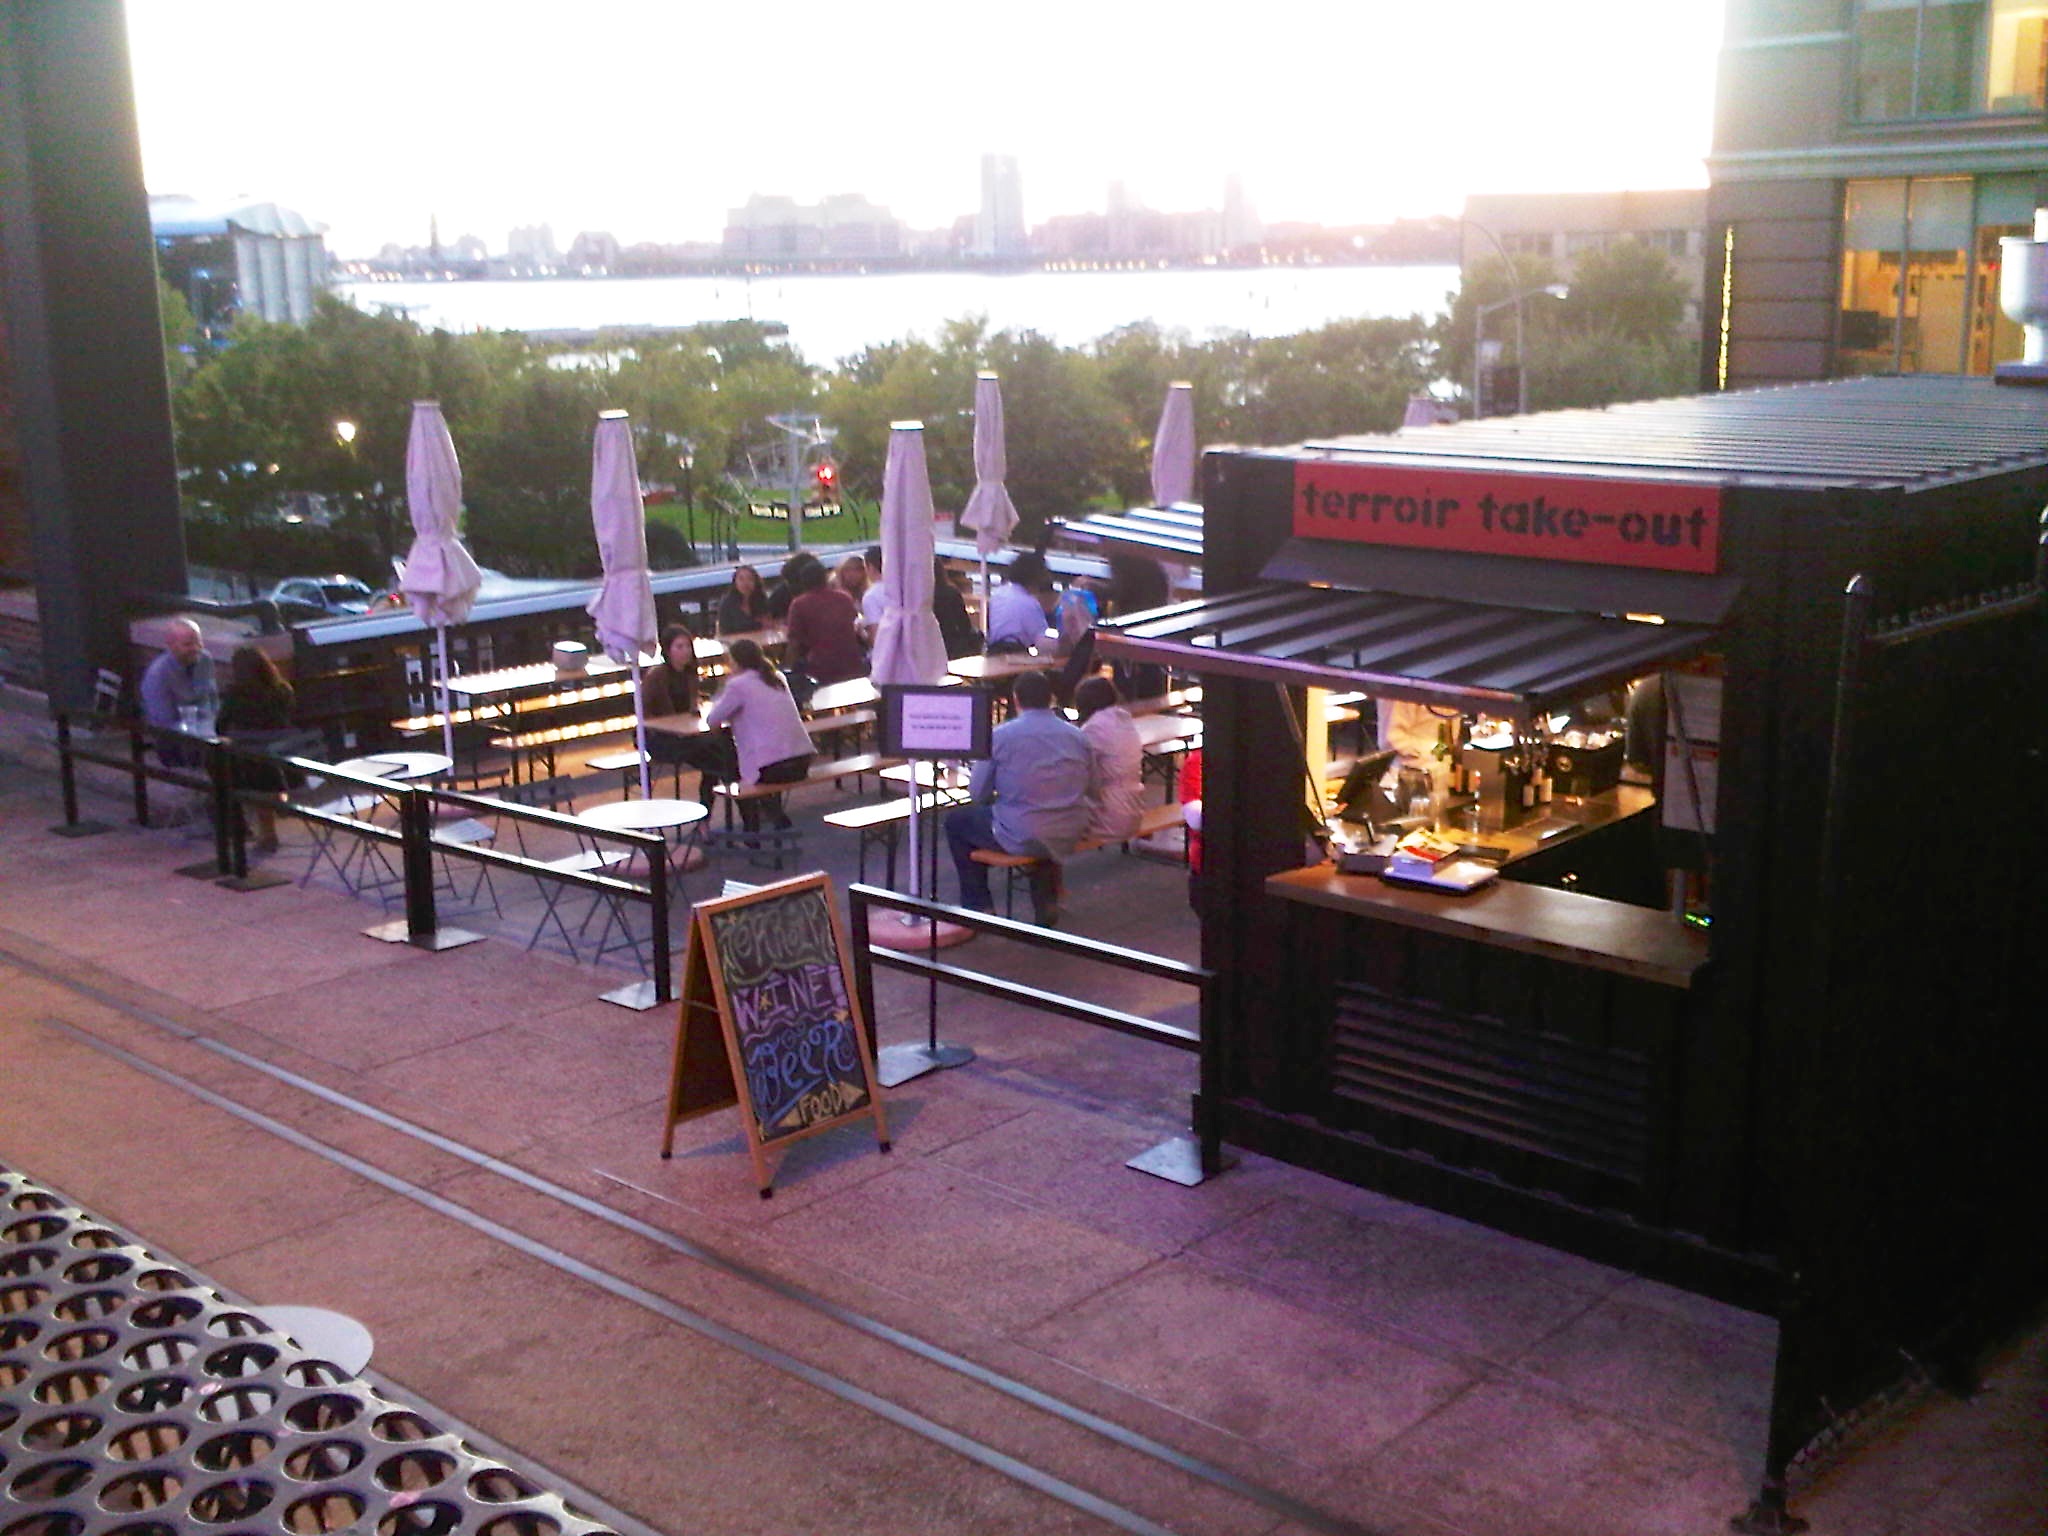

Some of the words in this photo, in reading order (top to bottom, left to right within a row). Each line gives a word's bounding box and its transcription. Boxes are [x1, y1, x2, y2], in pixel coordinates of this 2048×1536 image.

[1302, 481, 1460, 531] terroir
[1478, 490, 1708, 550] take-out
[798, 1083, 847, 1127] FOOD
